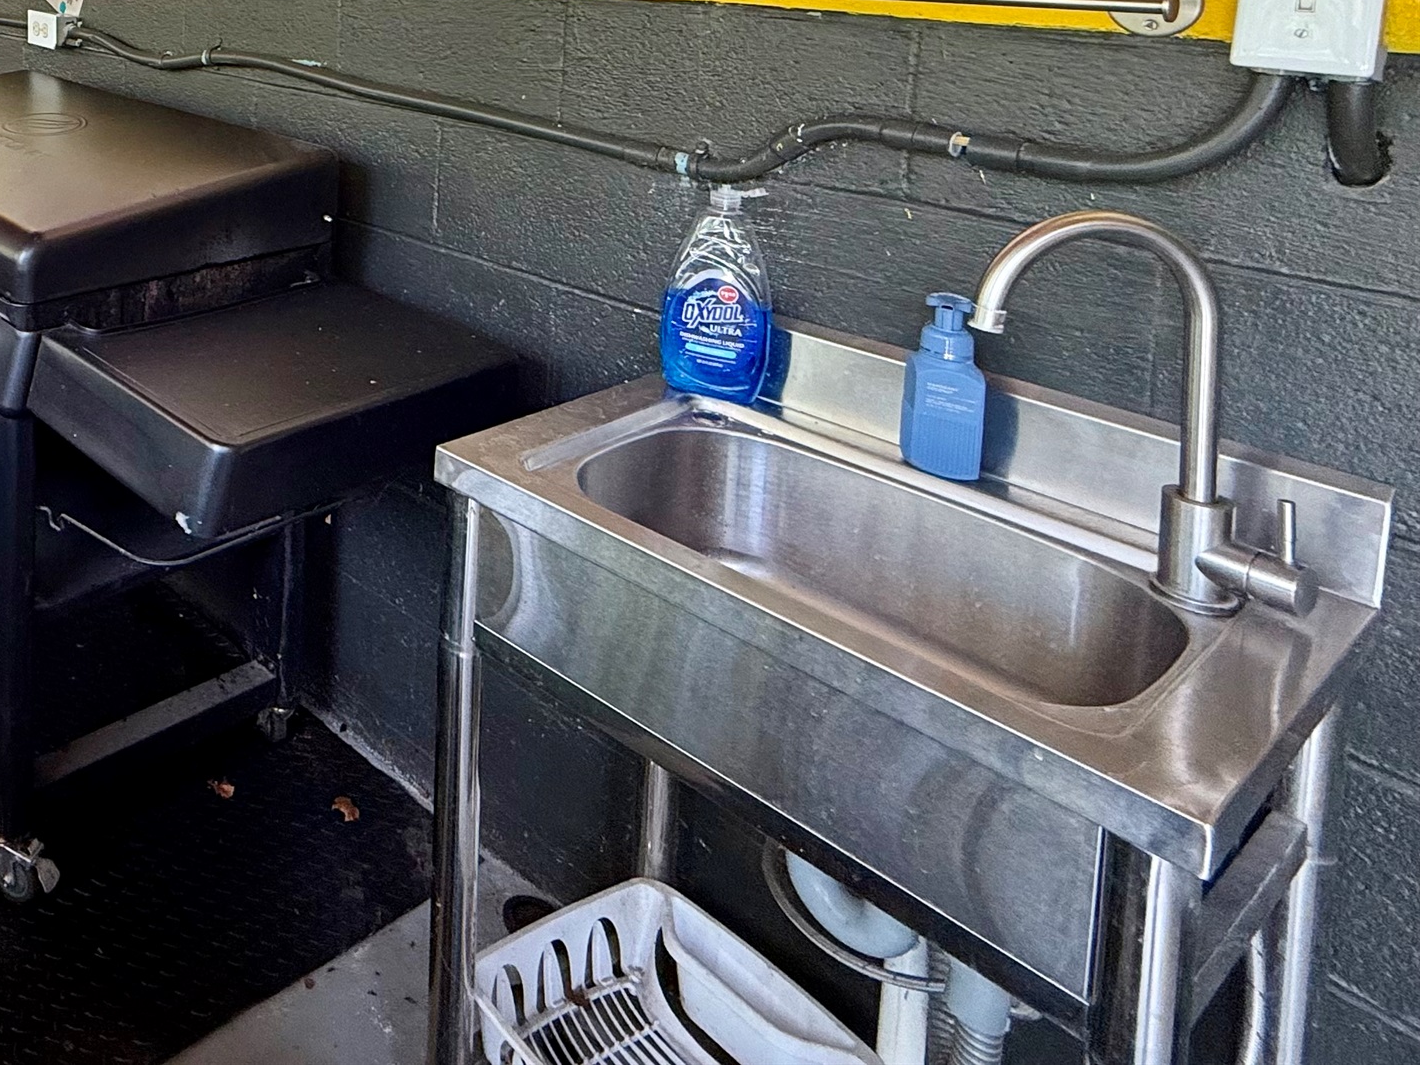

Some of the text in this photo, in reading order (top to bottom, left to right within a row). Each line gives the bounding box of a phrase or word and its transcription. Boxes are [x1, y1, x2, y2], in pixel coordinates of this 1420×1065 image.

[682, 297, 744, 329] OXYDOL
[710, 324, 743, 337] ULTRA
[679, 331, 745, 349] DISHWASHING LIQUID
